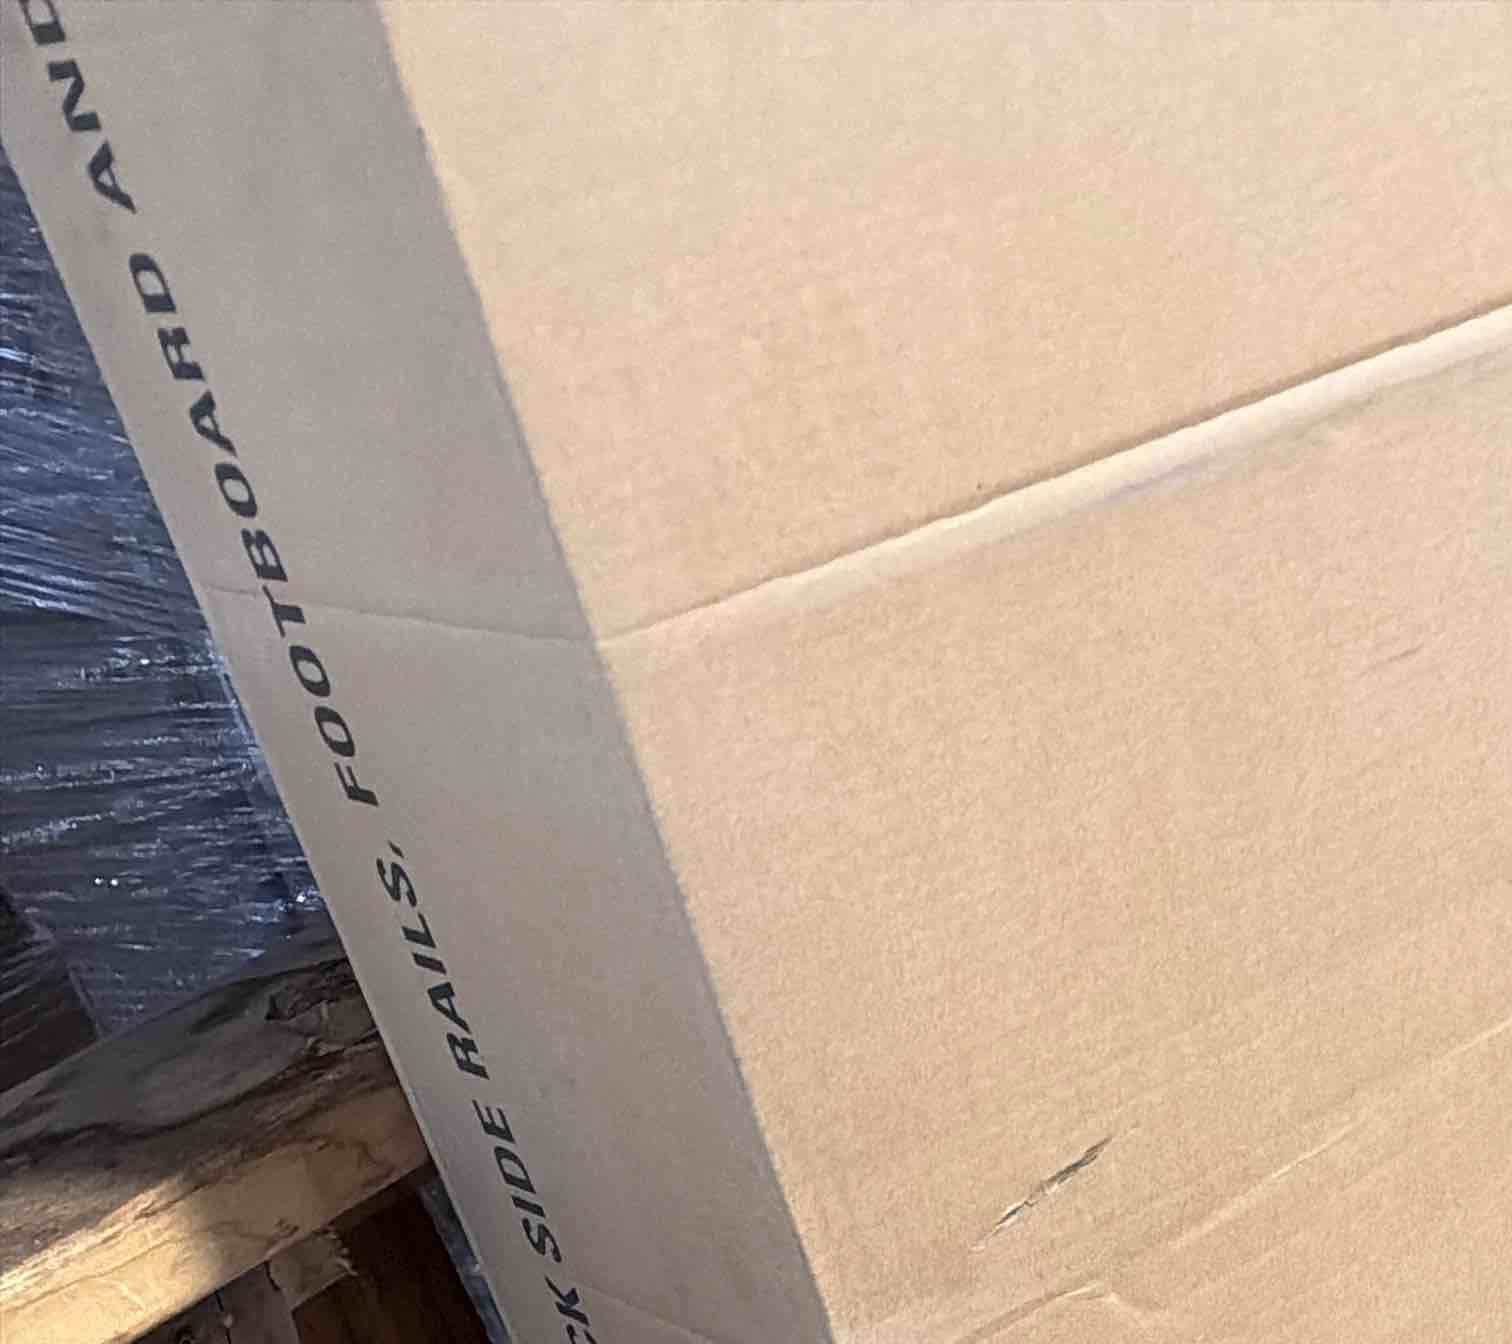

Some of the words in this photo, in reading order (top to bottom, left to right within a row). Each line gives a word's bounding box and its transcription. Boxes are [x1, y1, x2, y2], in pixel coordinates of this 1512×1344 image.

[20, 0, 136, 213] AND
[129, 253, 379, 807] FOOTBOARD
[377, 841, 489, 1080] RAILS,
[474, 1099, 564, 1263] SIDE
